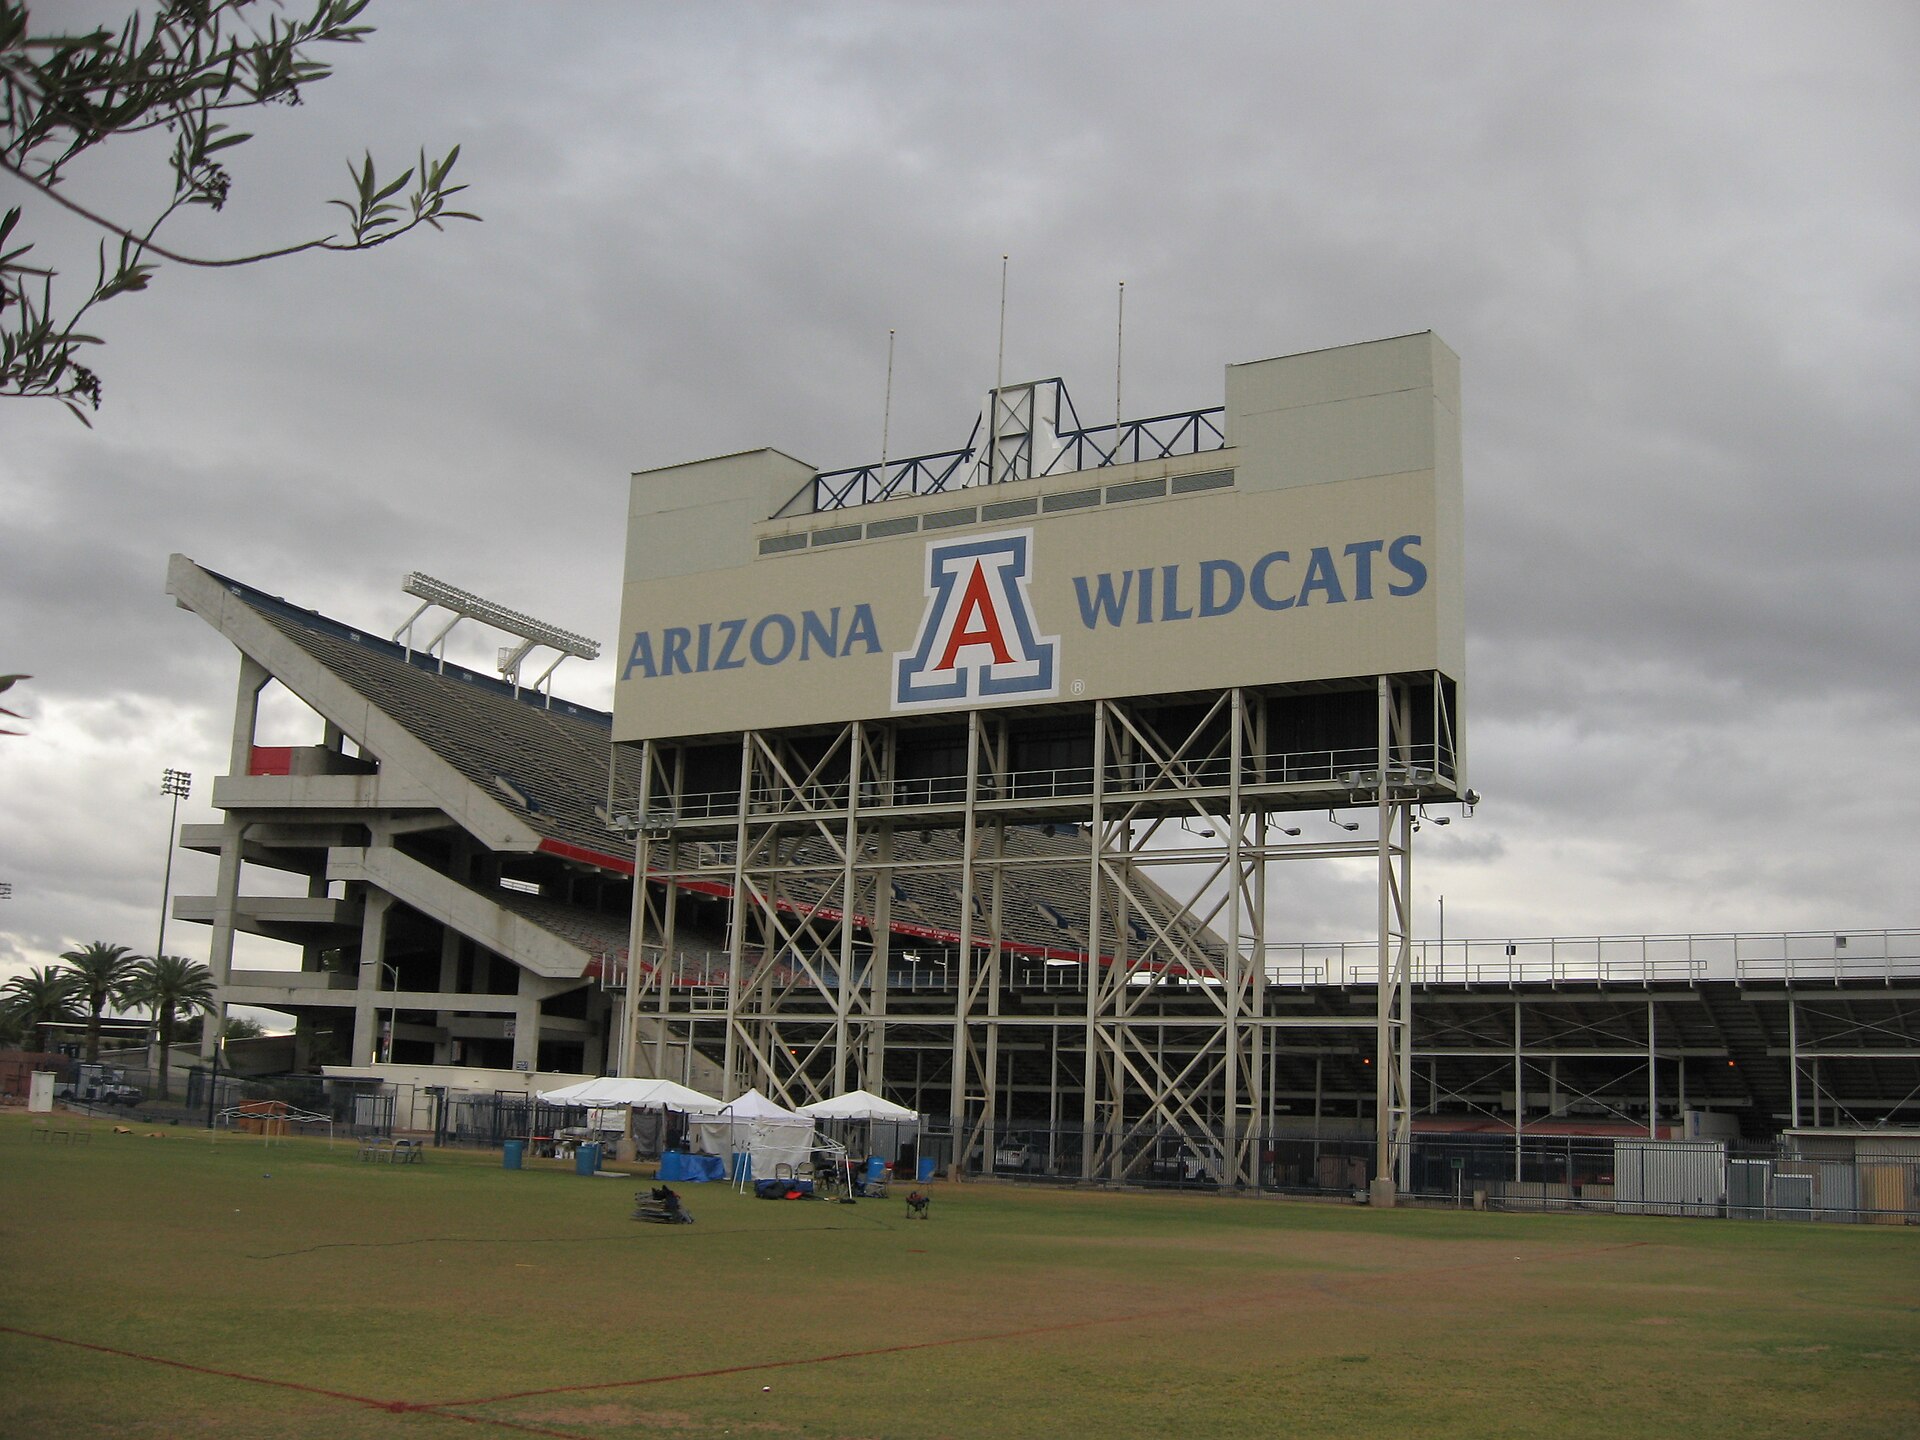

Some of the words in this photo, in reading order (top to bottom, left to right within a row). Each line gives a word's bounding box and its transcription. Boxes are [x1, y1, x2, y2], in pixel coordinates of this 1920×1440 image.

[620, 602, 883, 681] ARIZONA
[1071, 534, 1428, 631] WILDCATS
[894, 531, 1057, 708] A
